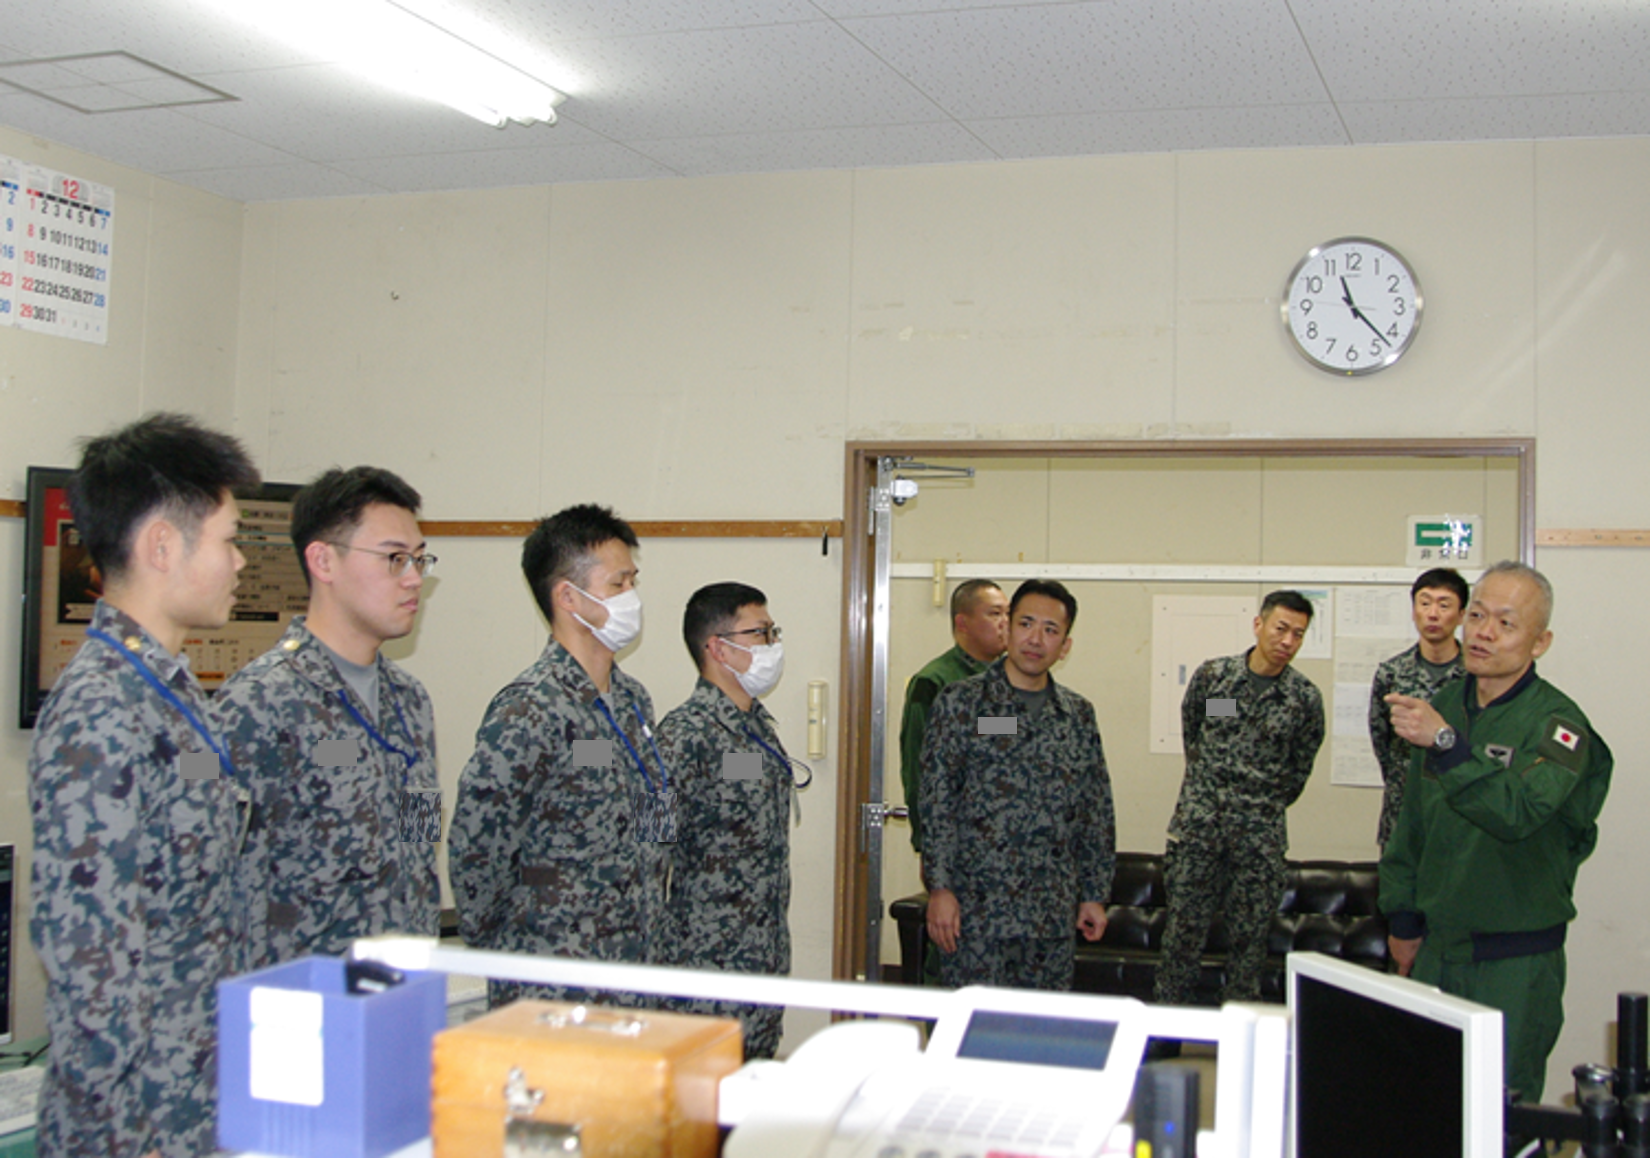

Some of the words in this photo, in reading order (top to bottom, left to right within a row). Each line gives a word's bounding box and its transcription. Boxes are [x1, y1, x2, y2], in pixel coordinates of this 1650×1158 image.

[8, 191, 16, 205] 2
[62, 179, 80, 199] 12
[30, 198, 35, 210] 1
[41, 201, 48, 214] 2
[54, 205, 60, 218] 3
[65, 208, 72, 220] 4
[77, 211, 84, 224] 5
[89, 214, 95, 227] 6
[101, 218, 107, 230] 7
[6, 218, 13, 231] 9
[27, 224, 34, 237] 8
[39, 227, 47, 240] 9
[50, 230, 61, 245] 10
[62, 233, 72, 247] 11
[74, 237, 85, 251] 12
[86, 240, 96, 253] 13
[97, 243, 108, 256] 14
[2, 244, 14, 259] 16
[24, 250, 35, 265] 15
[37, 253, 48, 267] 16
[48, 257, 60, 270] 17
[61, 260, 72, 273] 18
[73, 263, 83, 276] 19
[83, 266, 95, 279] 20
[95, 268, 106, 281] 21
[1324, 259, 1336, 276] 11
[1345, 252, 1362, 271] 12
[1374, 258, 1380, 275] 1
[22, 277, 34, 291] 22
[34, 280, 46, 293] 23
[46, 283, 58, 296] 24
[59, 286, 70, 300] 25
[71, 288, 82, 302] 26
[83, 291, 94, 304] 27
[94, 293, 105, 307] 28
[1306, 275, 1323, 294] 10
[1387, 274, 1400, 293] 2
[20, 304, 33, 318] 29
[33, 306, 45, 320] 30
[46, 309, 57, 323] 31
[1300, 298, 1313, 316] 9
[1393, 297, 1406, 316] 3
[1306, 321, 1318, 340] 8
[1386, 321, 1399, 337] 4
[1325, 338, 1336, 354] 7
[1346, 344, 1358, 362] 6
[1370, 339, 1381, 356] 5
